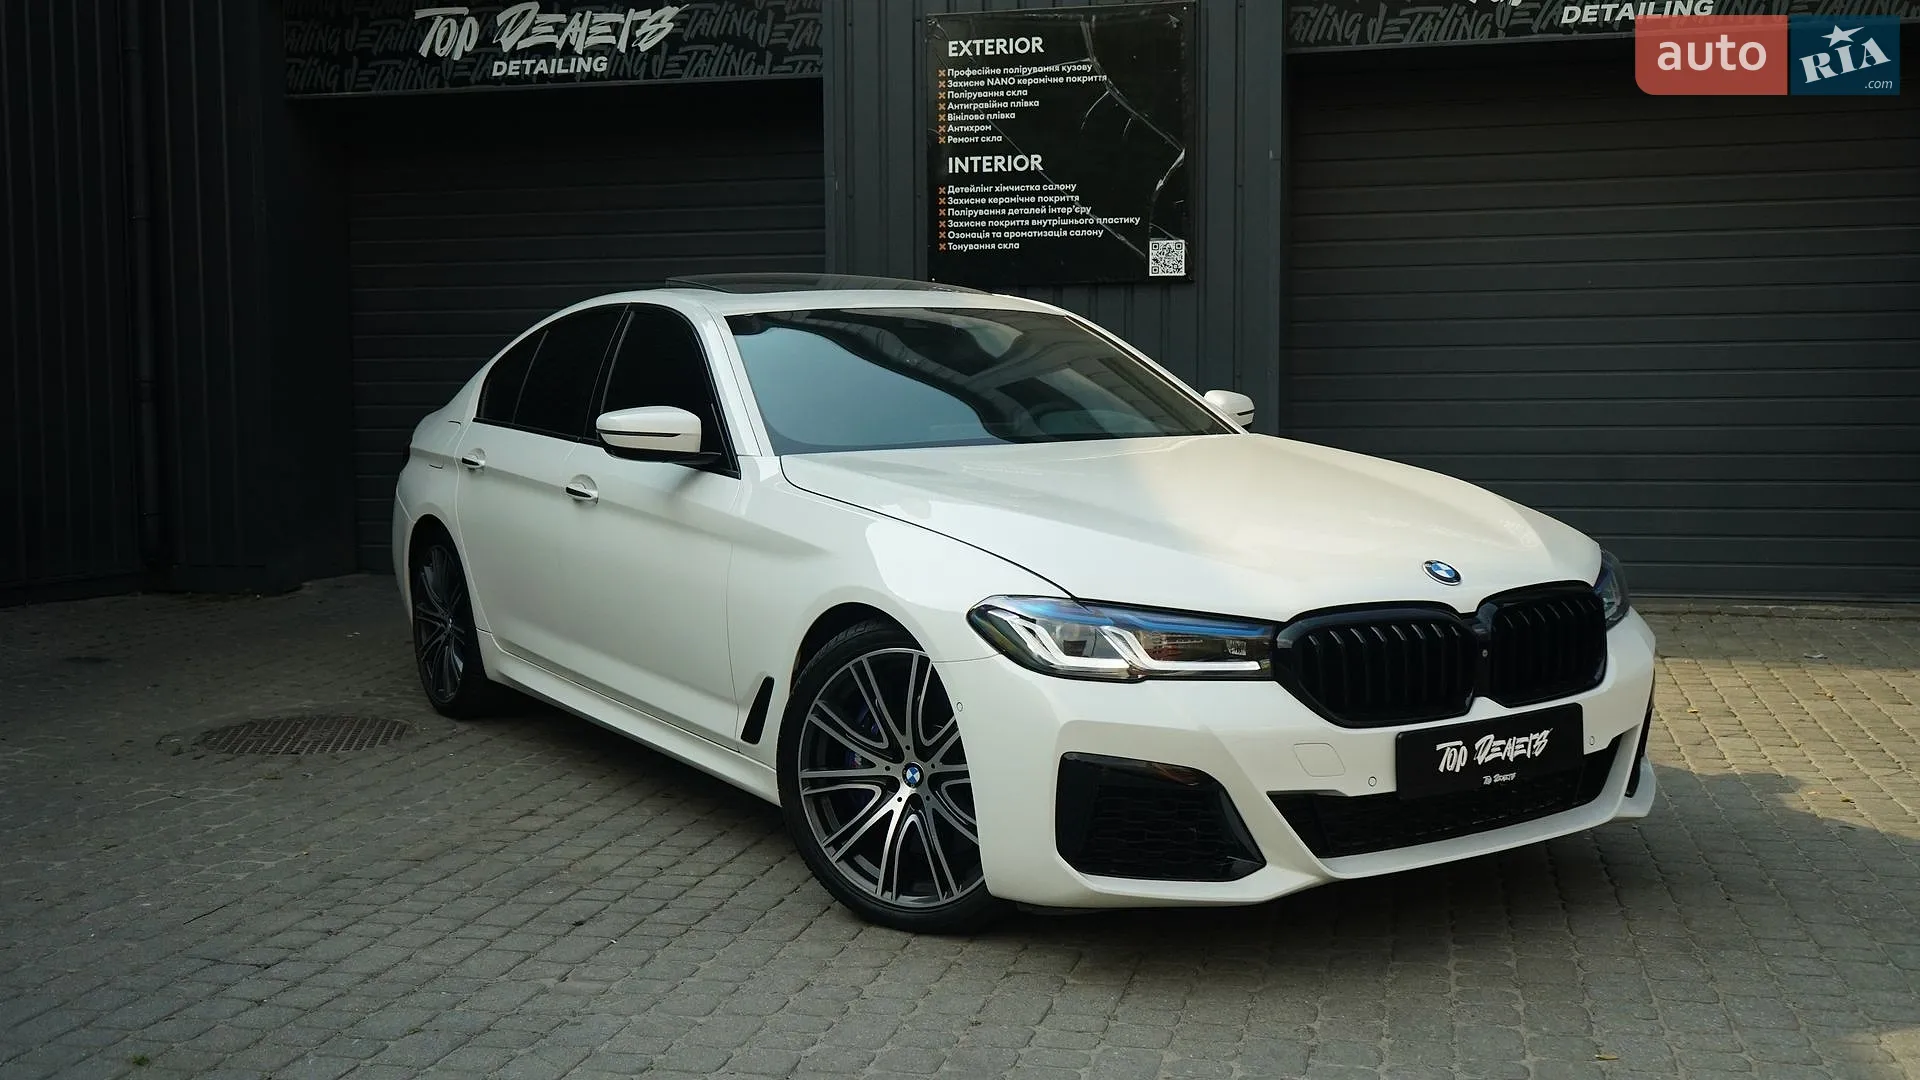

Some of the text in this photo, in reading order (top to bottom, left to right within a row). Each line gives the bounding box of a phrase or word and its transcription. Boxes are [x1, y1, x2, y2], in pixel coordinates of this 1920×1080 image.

[1561, 0, 1714, 24] DETAILING
[948, 37, 1045, 57] EXTERIOR
[492, 55, 608, 77] DETAILING
[948, 63, 1093, 78] Професійне полірування кузову
[948, 75, 1108, 88] Захисне NANO керамічне покриття
[948, 88, 1028, 100] Полірування скла
[947, 99, 1040, 111] Антигравійна плівка
[947, 111, 1016, 121] Вінілова плівка
[947, 124, 992, 133] Антихром
[947, 135, 979, 143] Ремонт
[948, 154, 1044, 173] INTERIOR
[948, 183, 1077, 194] Детейлінг хімчистка салону
[948, 195, 1080, 206] Захисне керамічне покриття
[948, 207, 1006, 217] Полірування
[1008, 205, 1046, 216] деталей
[948, 216, 1141, 228] Захисне покриття внутрішнього пластику
[947, 230, 990, 239] Озонація
[1003, 228, 1068, 239] ароматизація
[1069, 229, 1104, 238] салону
[948, 242, 1020, 252] Тонування скла
